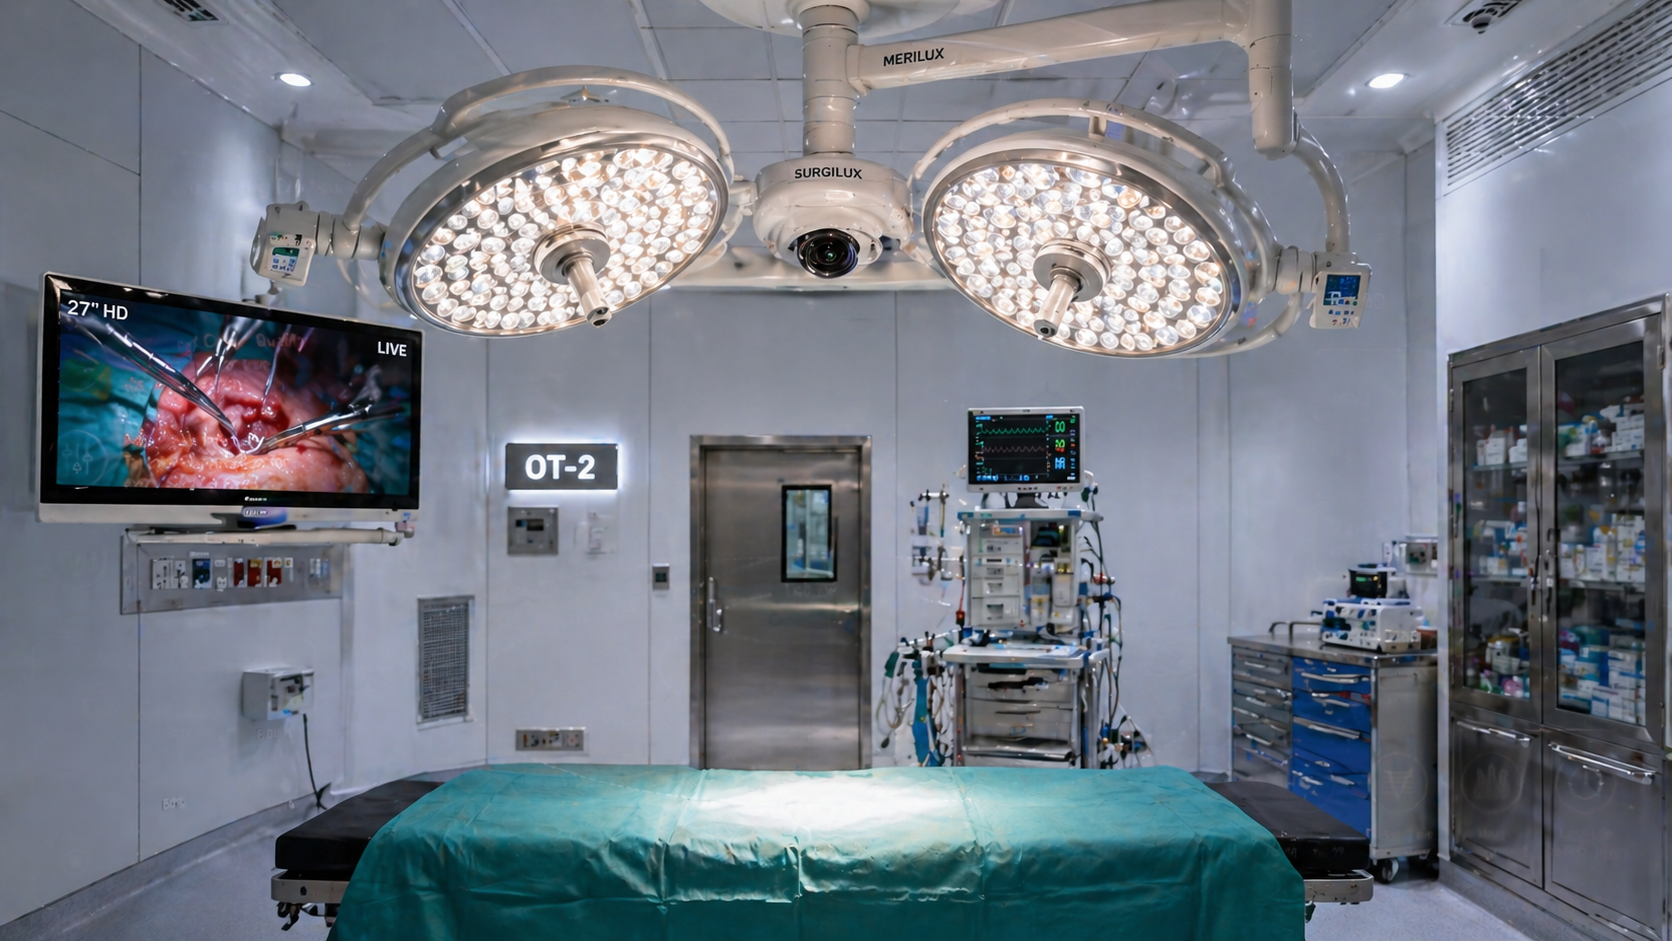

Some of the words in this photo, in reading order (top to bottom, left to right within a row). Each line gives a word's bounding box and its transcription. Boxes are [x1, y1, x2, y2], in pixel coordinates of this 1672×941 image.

[883, 47, 945, 67] MERILUX
[794, 166, 863, 180] SURGILUX
[67, 299, 99, 316] 27"
[103, 303, 129, 320] HD
[377, 340, 408, 357] LIVE
[525, 453, 596, 480] OT-2
